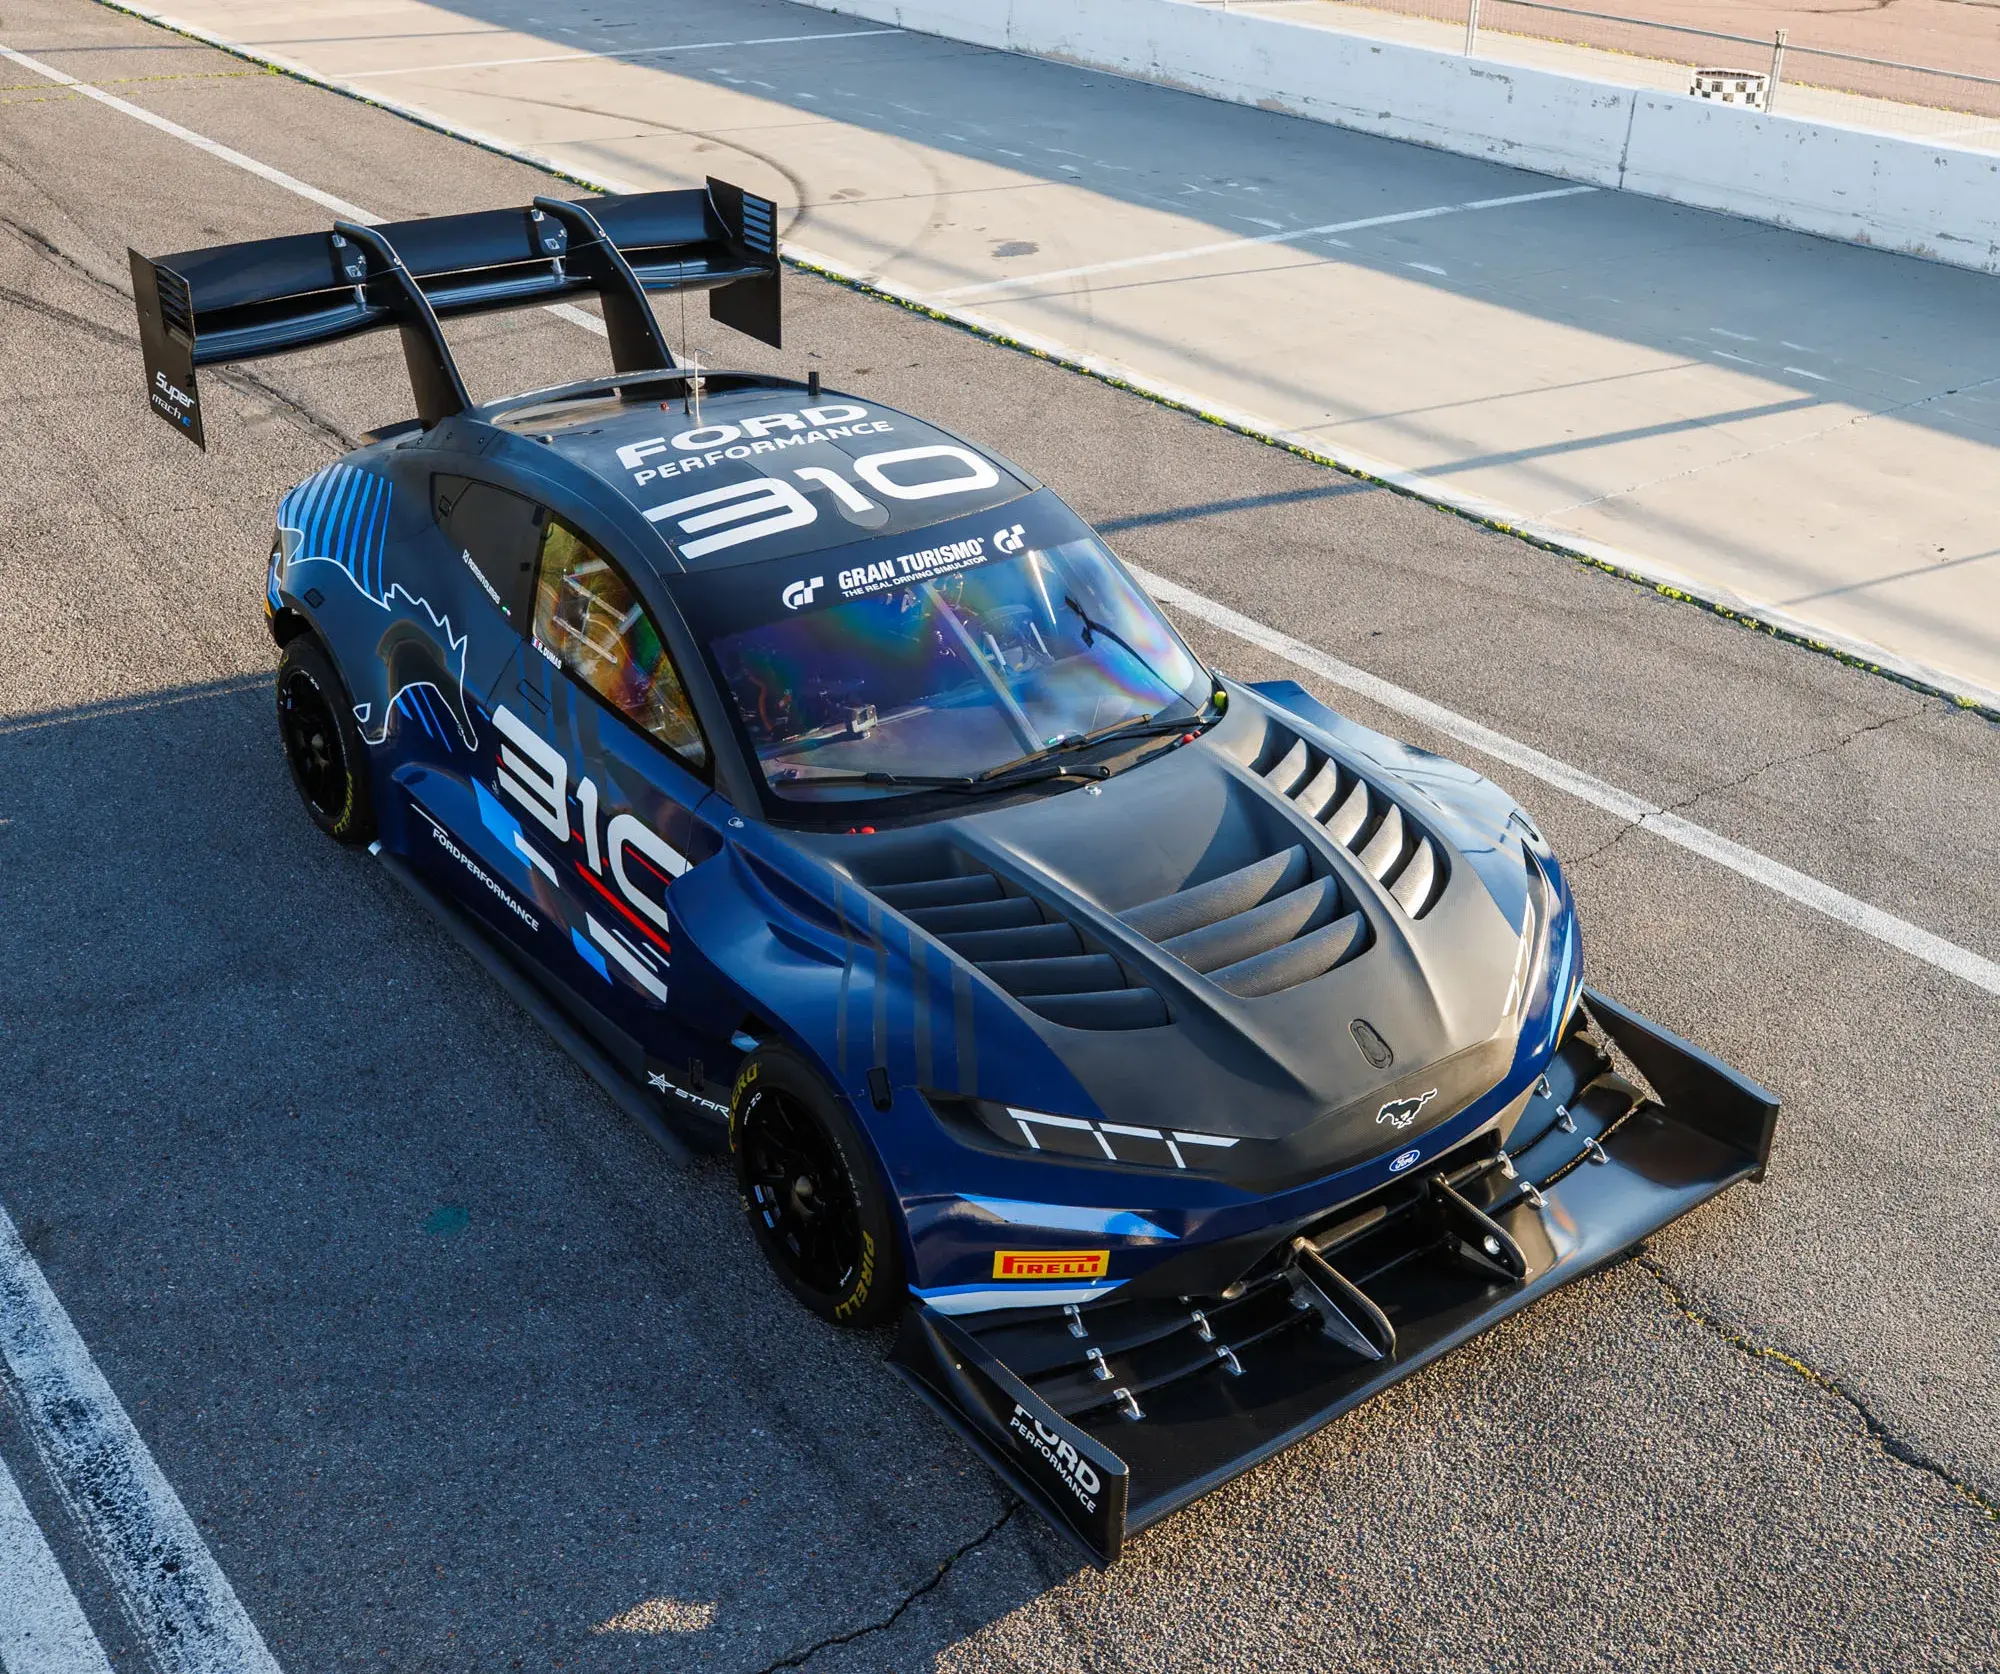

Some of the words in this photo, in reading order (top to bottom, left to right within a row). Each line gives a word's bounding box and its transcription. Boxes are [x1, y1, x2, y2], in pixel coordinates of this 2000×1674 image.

[155, 371, 195, 408] Super
[615, 404, 868, 470] FORD
[634, 420, 894, 486] PERFORMANCE
[642, 445, 1000, 560] 310
[838, 558, 895, 591] GRAN
[842, 585, 865, 598] THE
[866, 580, 893, 594] REAL
[893, 570, 934, 586] DRIVING
[934, 555, 988, 576] SIMULATOR
[543, 645, 563, 670] DUMAS
[835, 1230, 875, 1320] PIRELLI
[1002, 1255, 1102, 1275] PIRELLI
[1010, 1416, 1097, 1514] PERFORMANCE
